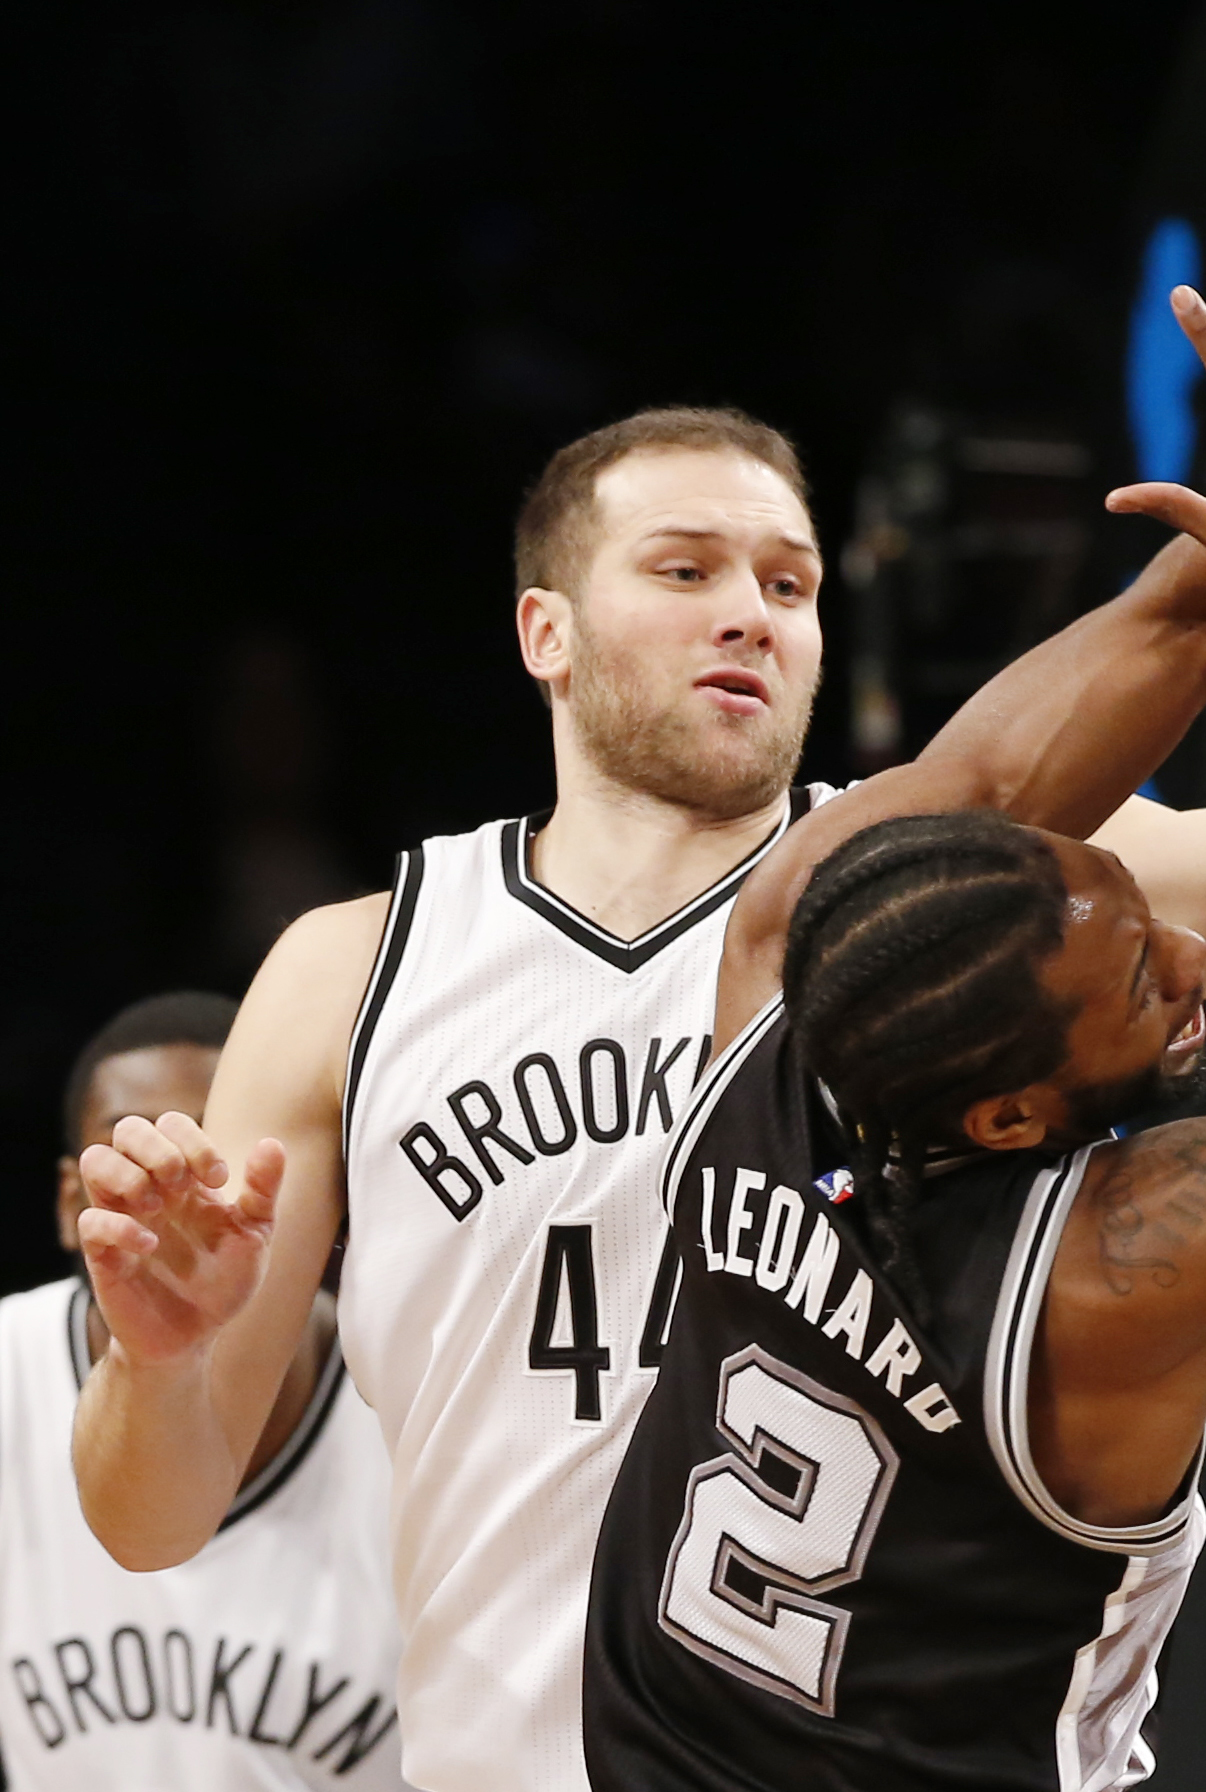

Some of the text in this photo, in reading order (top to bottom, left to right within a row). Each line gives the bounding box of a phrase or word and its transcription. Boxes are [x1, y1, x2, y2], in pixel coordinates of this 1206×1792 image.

[701, 1166, 962, 1434] LEONARD
[657, 1342, 900, 1719] 2
[12, 1624, 399, 1776] BROOKLYN
